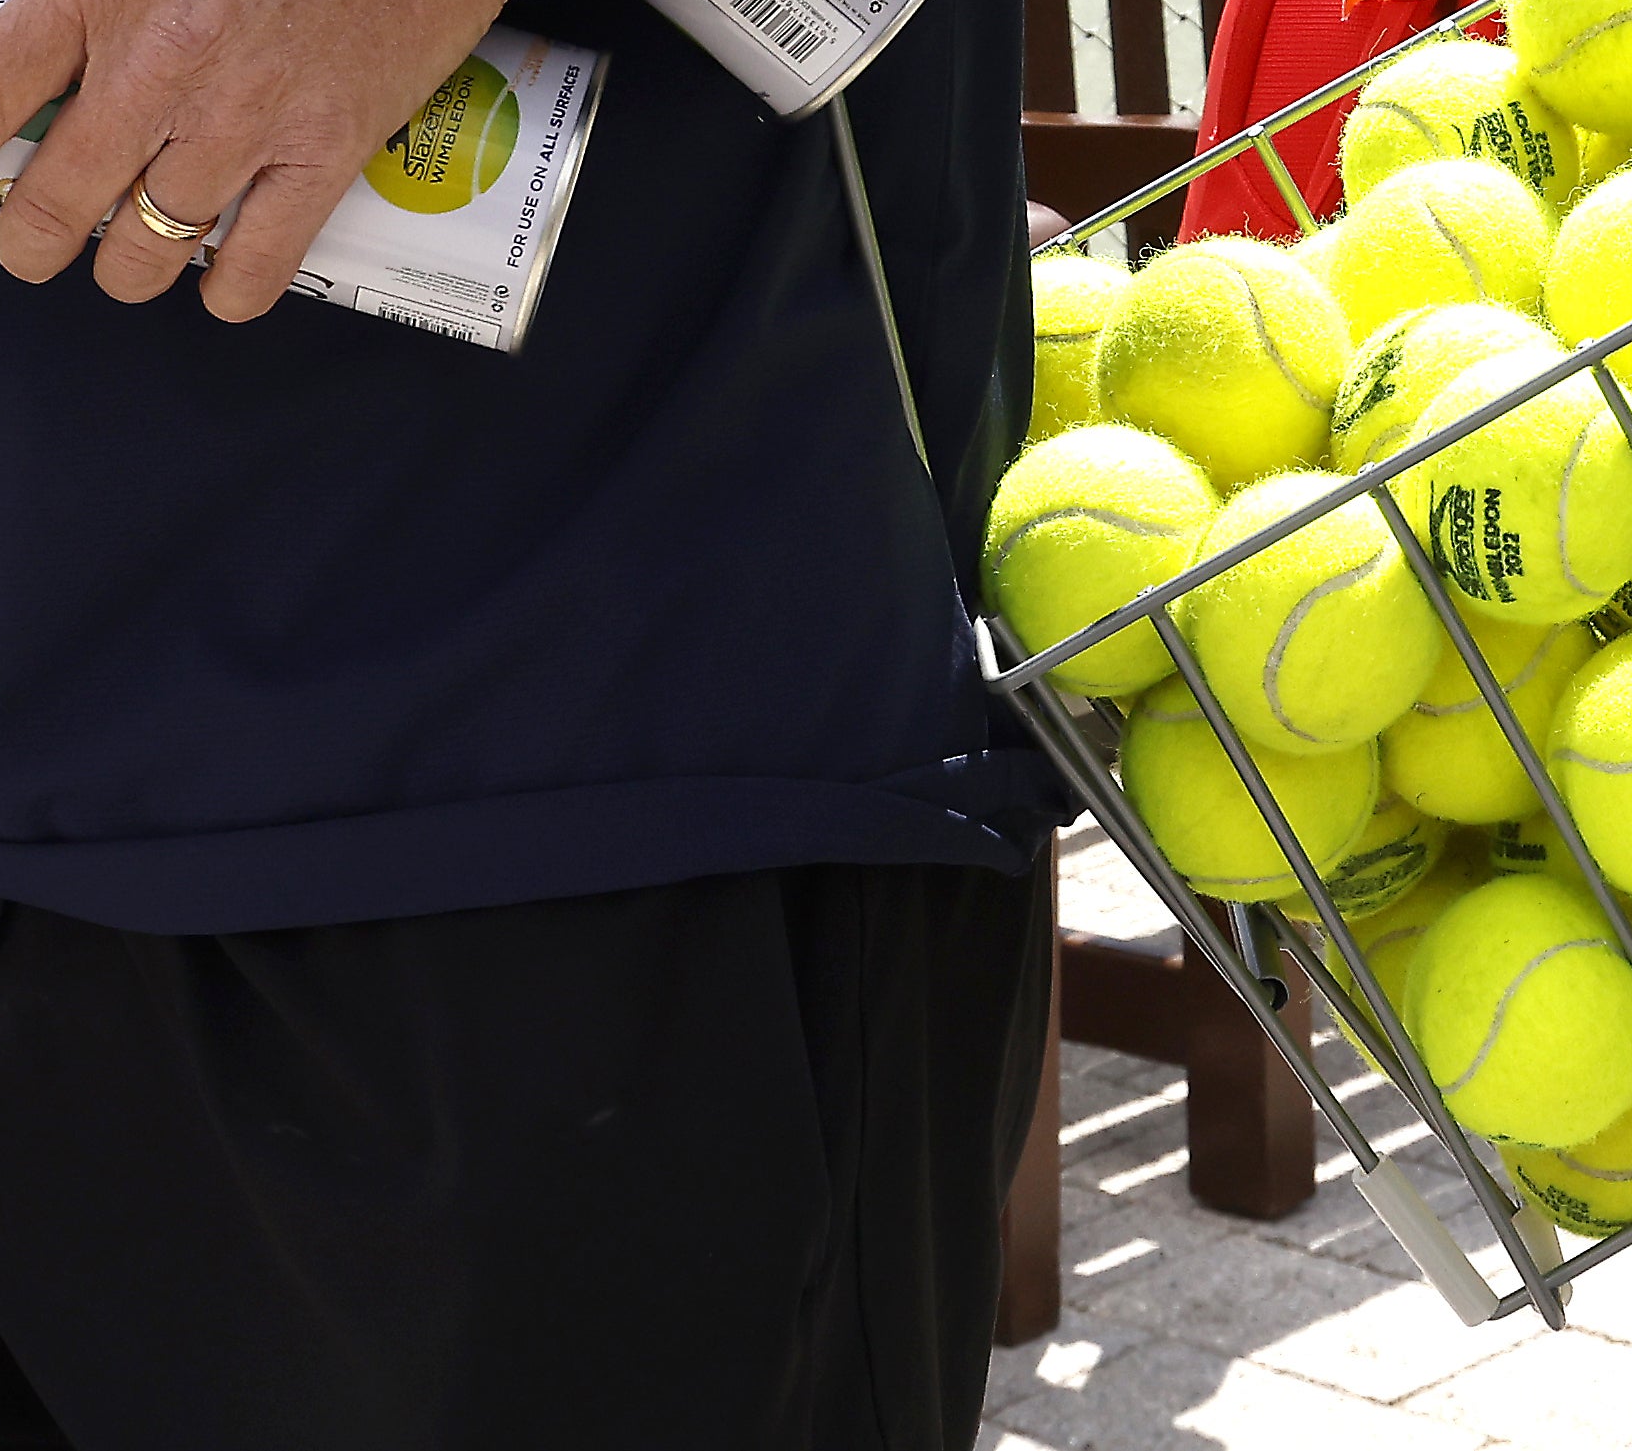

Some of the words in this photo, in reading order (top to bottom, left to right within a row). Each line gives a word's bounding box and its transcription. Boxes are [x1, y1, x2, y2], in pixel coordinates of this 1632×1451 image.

[549, 64, 581, 128] SURFACES
[405, 71, 460, 181] Slazenge
[429, 75, 475, 184] WIMBLEDON
[538, 132, 560, 163] ALL
[529, 166, 549, 192] ON
[517, 195, 539, 230] USE
[506, 233, 528, 268] FOR
[1483, 487, 1517, 603] WIMBLEDON
[1502, 532, 1525, 577] 2022
